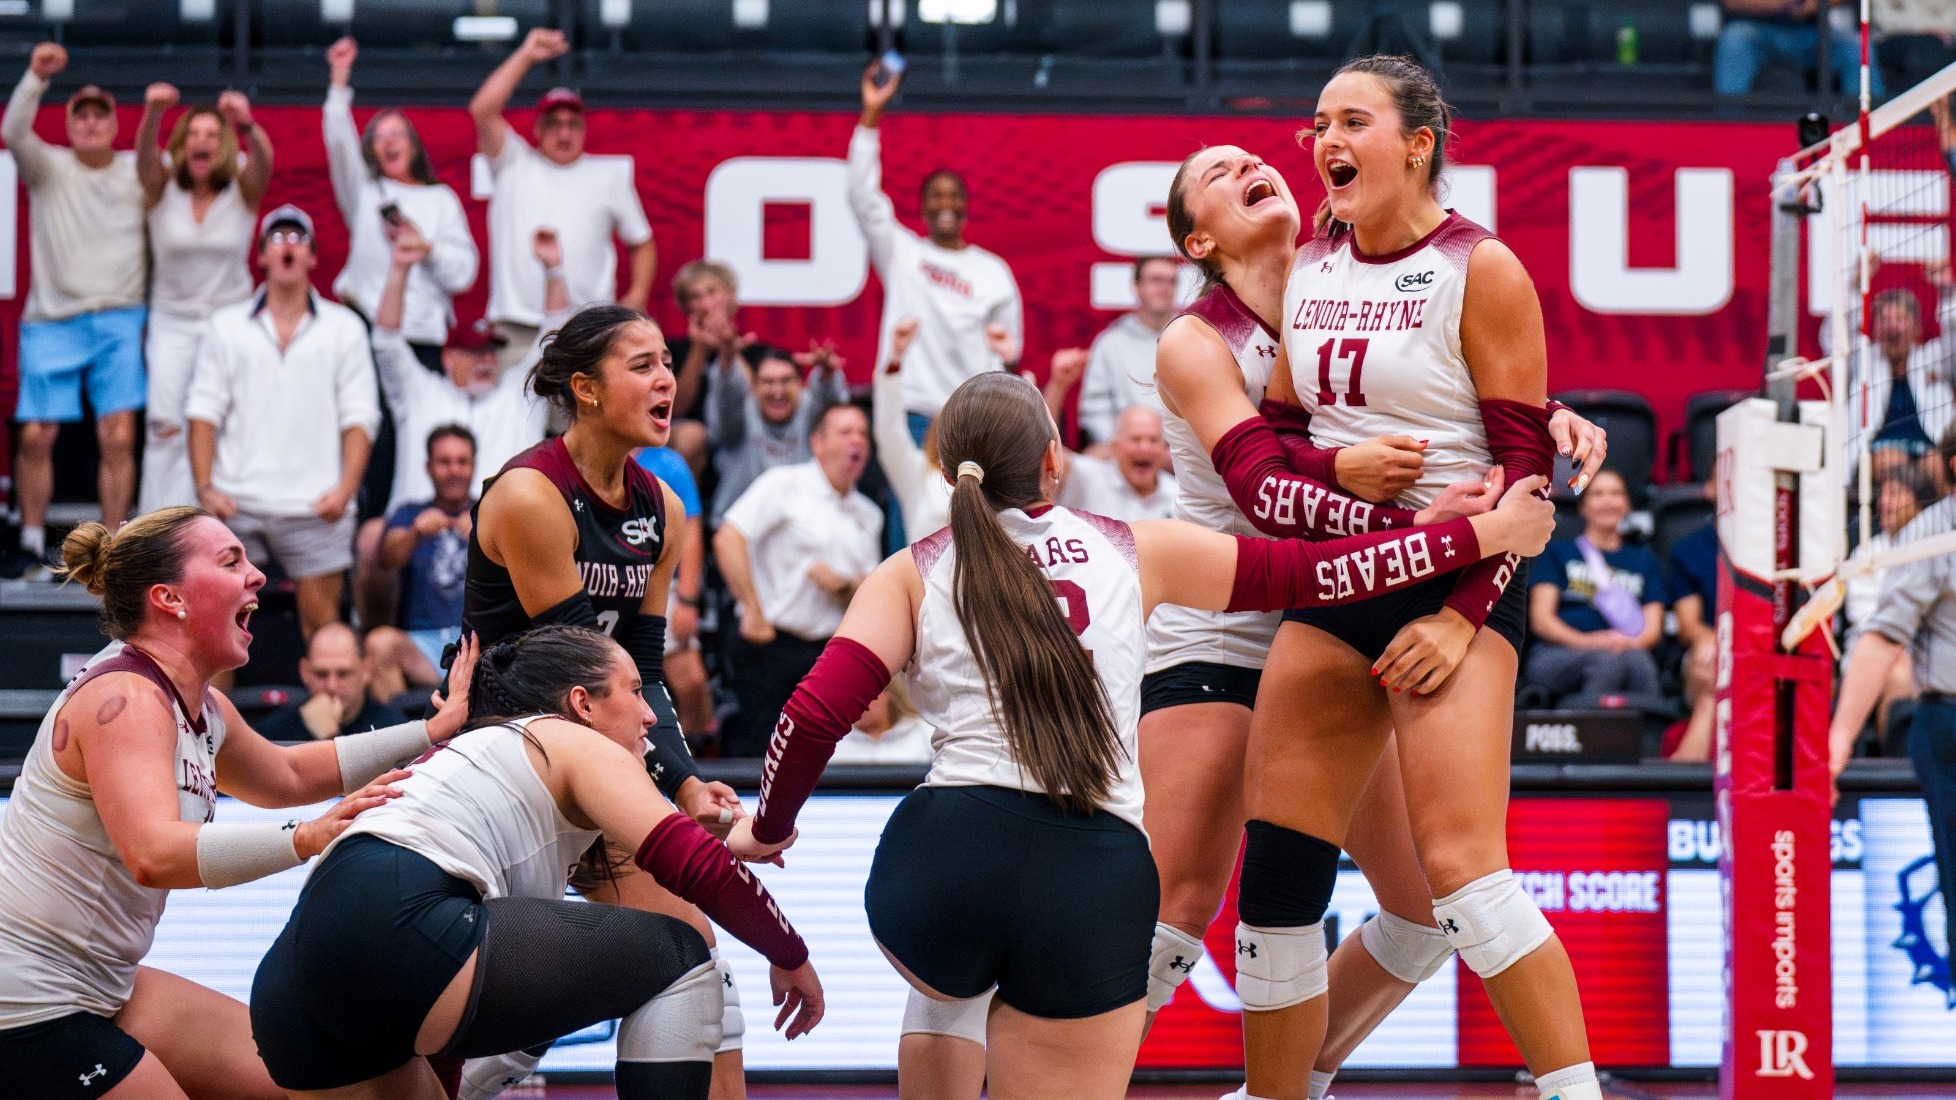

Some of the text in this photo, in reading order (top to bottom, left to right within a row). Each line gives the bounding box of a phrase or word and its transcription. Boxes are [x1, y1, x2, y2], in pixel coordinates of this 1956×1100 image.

[1400, 271, 1435, 288] SAC
[1293, 298, 1428, 332] LENOIR-RHYNE
[1316, 338, 1370, 407] 17
[1253, 475, 1374, 537] BEARS
[1026, 537, 1090, 569] ARS
[1315, 531, 1435, 601] BEARS
[1567, 870, 1661, 913] SCORE
[1770, 829, 1799, 1009] sports imports
[1755, 1029, 1815, 1081] LR
